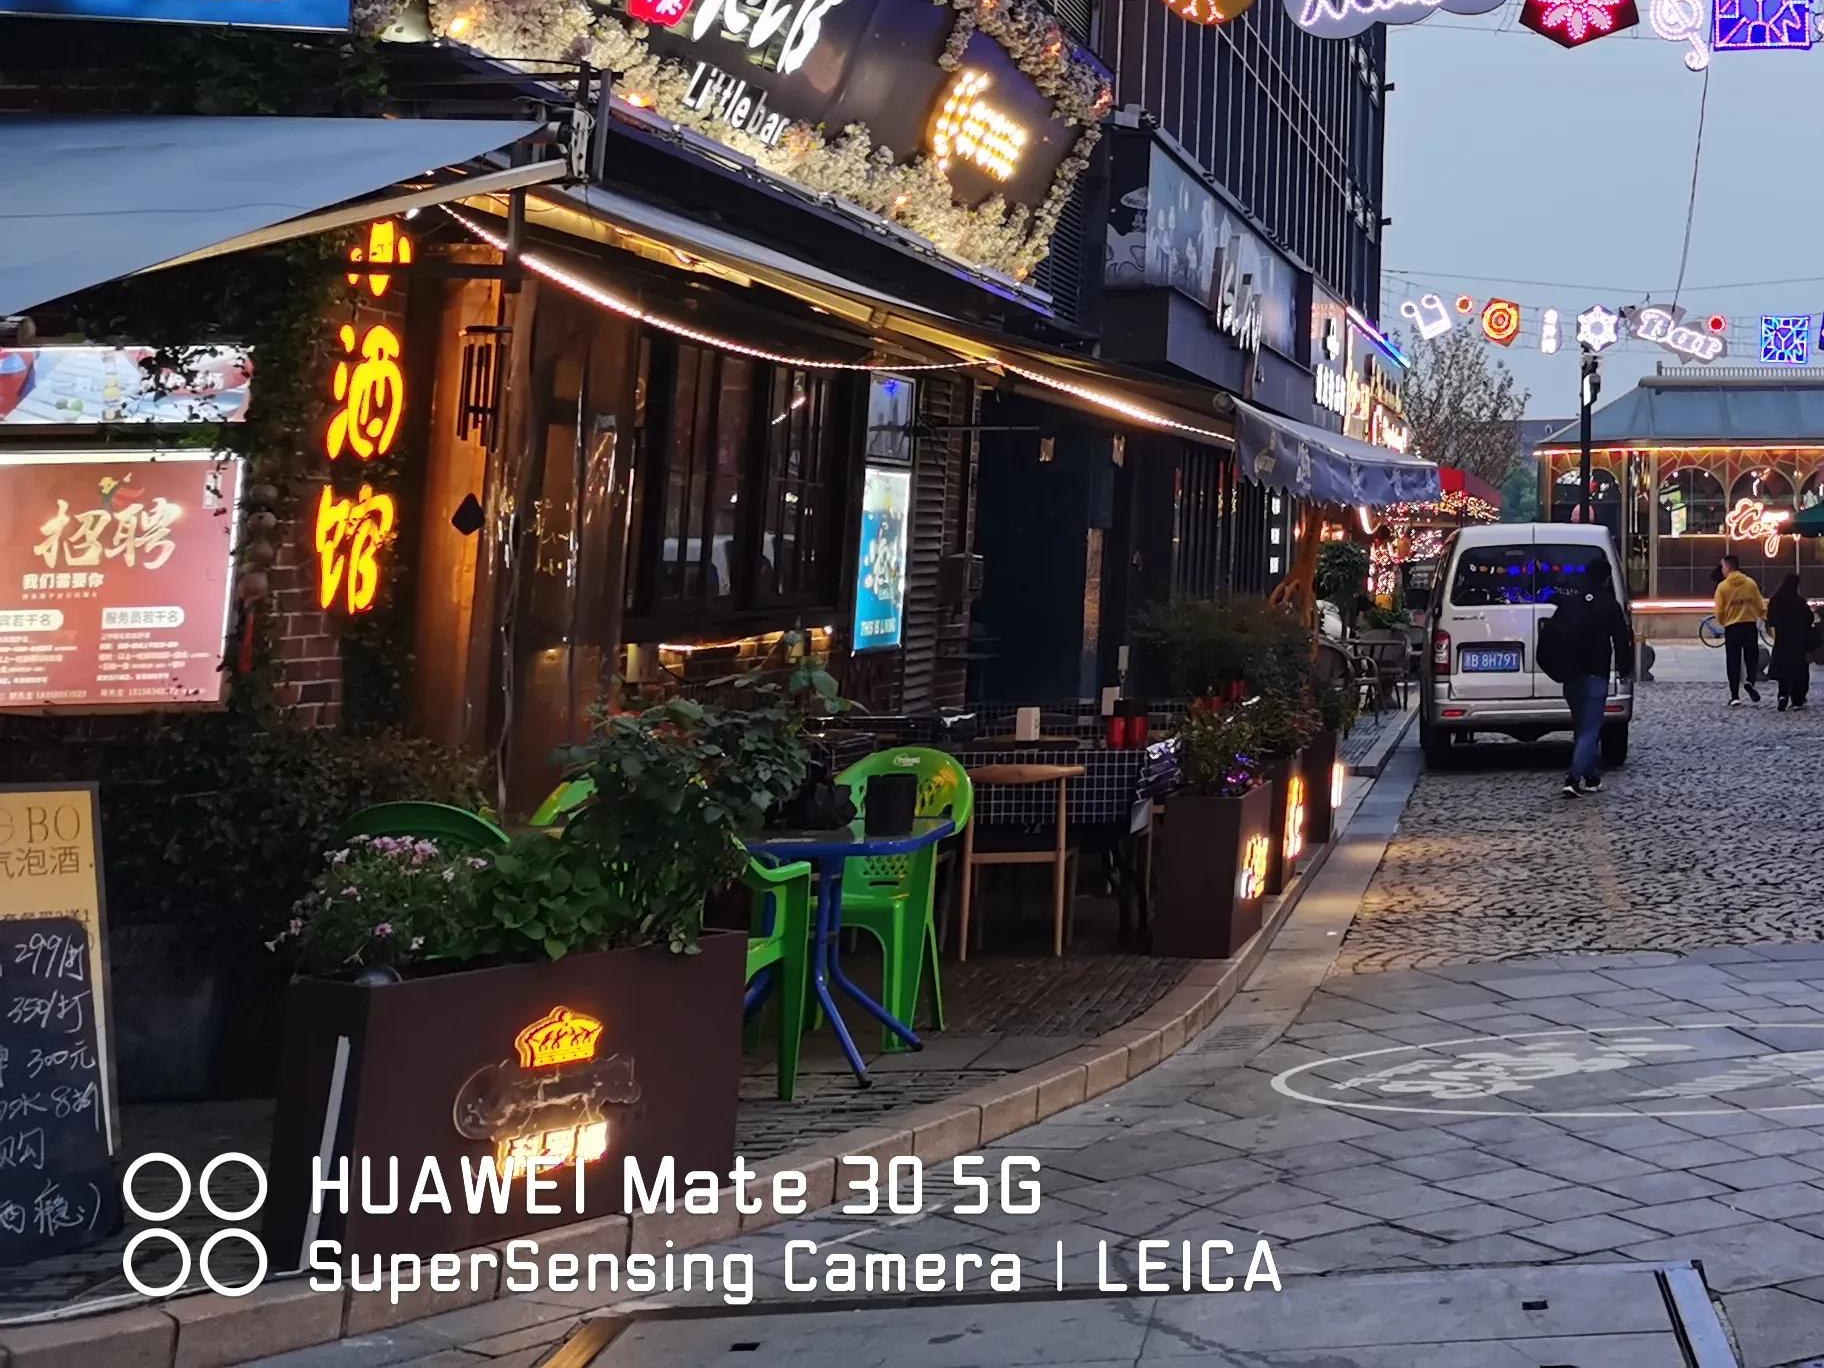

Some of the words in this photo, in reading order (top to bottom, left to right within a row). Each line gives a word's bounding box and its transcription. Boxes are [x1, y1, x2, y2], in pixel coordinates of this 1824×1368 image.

[680, 60, 751, 125] Little
[750, 95, 791, 146] bar
[315, 219, 411, 616] 小酒馆
[32, 496, 183, 570] 招聘
[22, 571, 105, 591] 我们需要你
[104, 609, 179, 626] 服务员若干名
